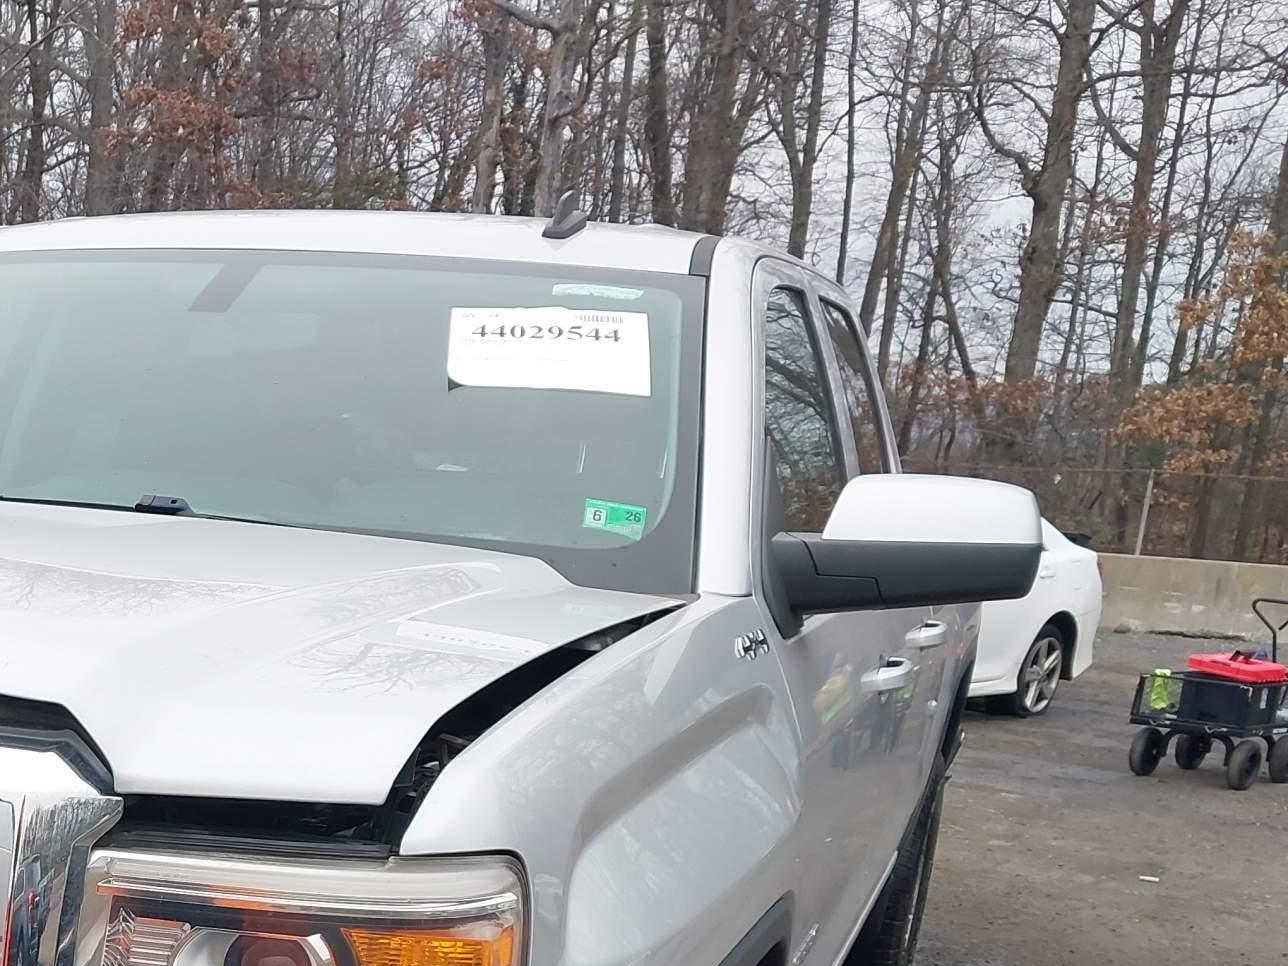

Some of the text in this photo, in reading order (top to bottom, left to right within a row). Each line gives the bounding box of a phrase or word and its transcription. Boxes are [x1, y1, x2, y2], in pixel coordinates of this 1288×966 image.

[471, 324, 623, 343] 44029544
[592, 509, 642, 523] 6 26
